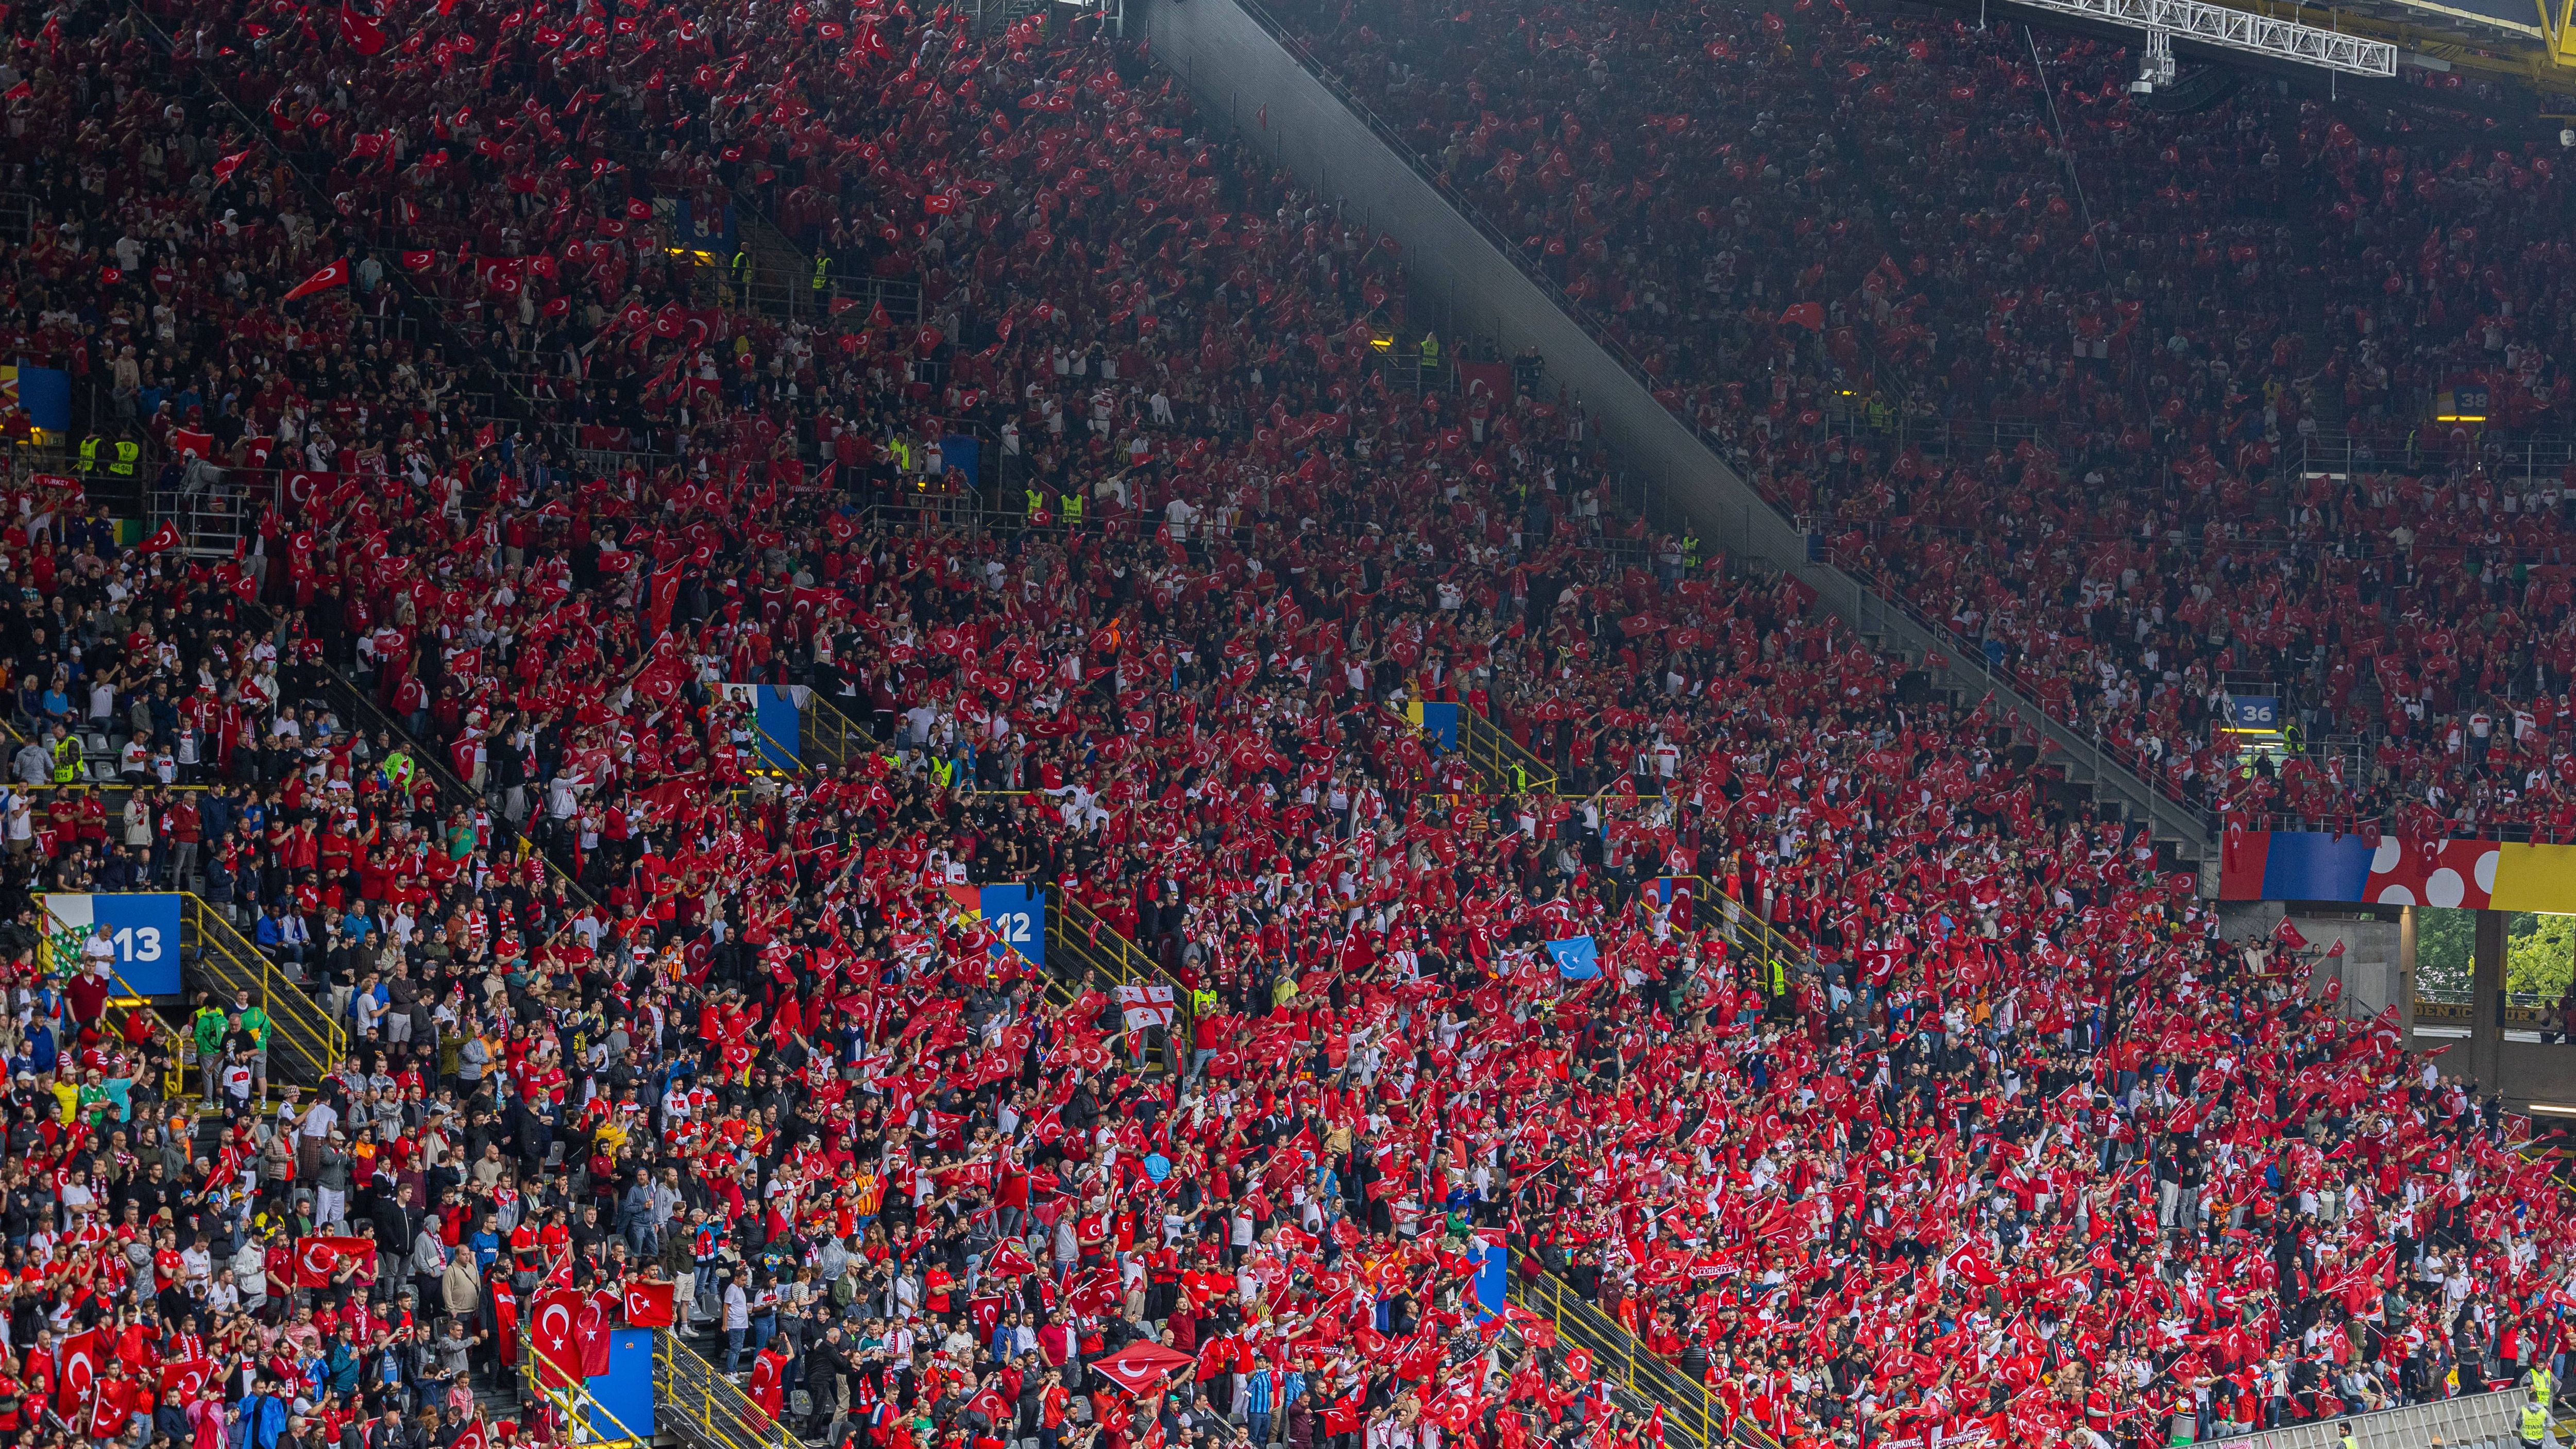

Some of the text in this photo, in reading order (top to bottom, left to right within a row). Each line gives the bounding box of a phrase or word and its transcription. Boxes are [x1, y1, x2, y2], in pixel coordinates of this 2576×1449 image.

[2460, 393, 2488, 408] 38
[43, 478, 69, 486] TURKEY
[2243, 706, 2272, 721] 36
[996, 913, 1030, 942] 12
[113, 927, 161, 962] 13
[2096, 1116, 2106, 1125] 21
